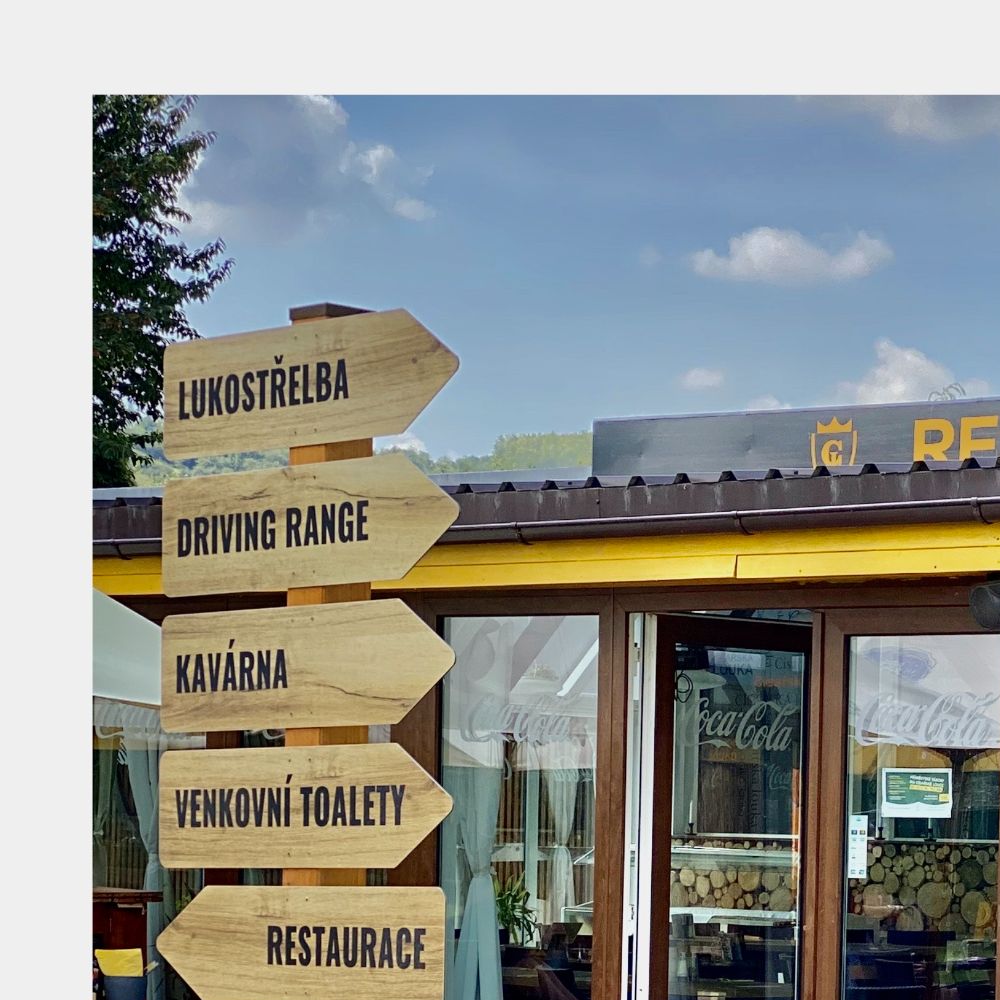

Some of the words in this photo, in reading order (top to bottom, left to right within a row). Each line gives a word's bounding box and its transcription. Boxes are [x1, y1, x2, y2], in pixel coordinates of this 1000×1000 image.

[178, 355, 349, 420] LUKOSTŘELBA
[177, 509, 276, 558] DRIVING
[285, 500, 369, 547] RANGE
[176, 638, 288, 694] KAVÁRNA
[175, 774, 292, 828] VENKOVNÍ
[300, 785, 406, 827] TOALETY
[267, 926, 426, 969] RESTAURACE
